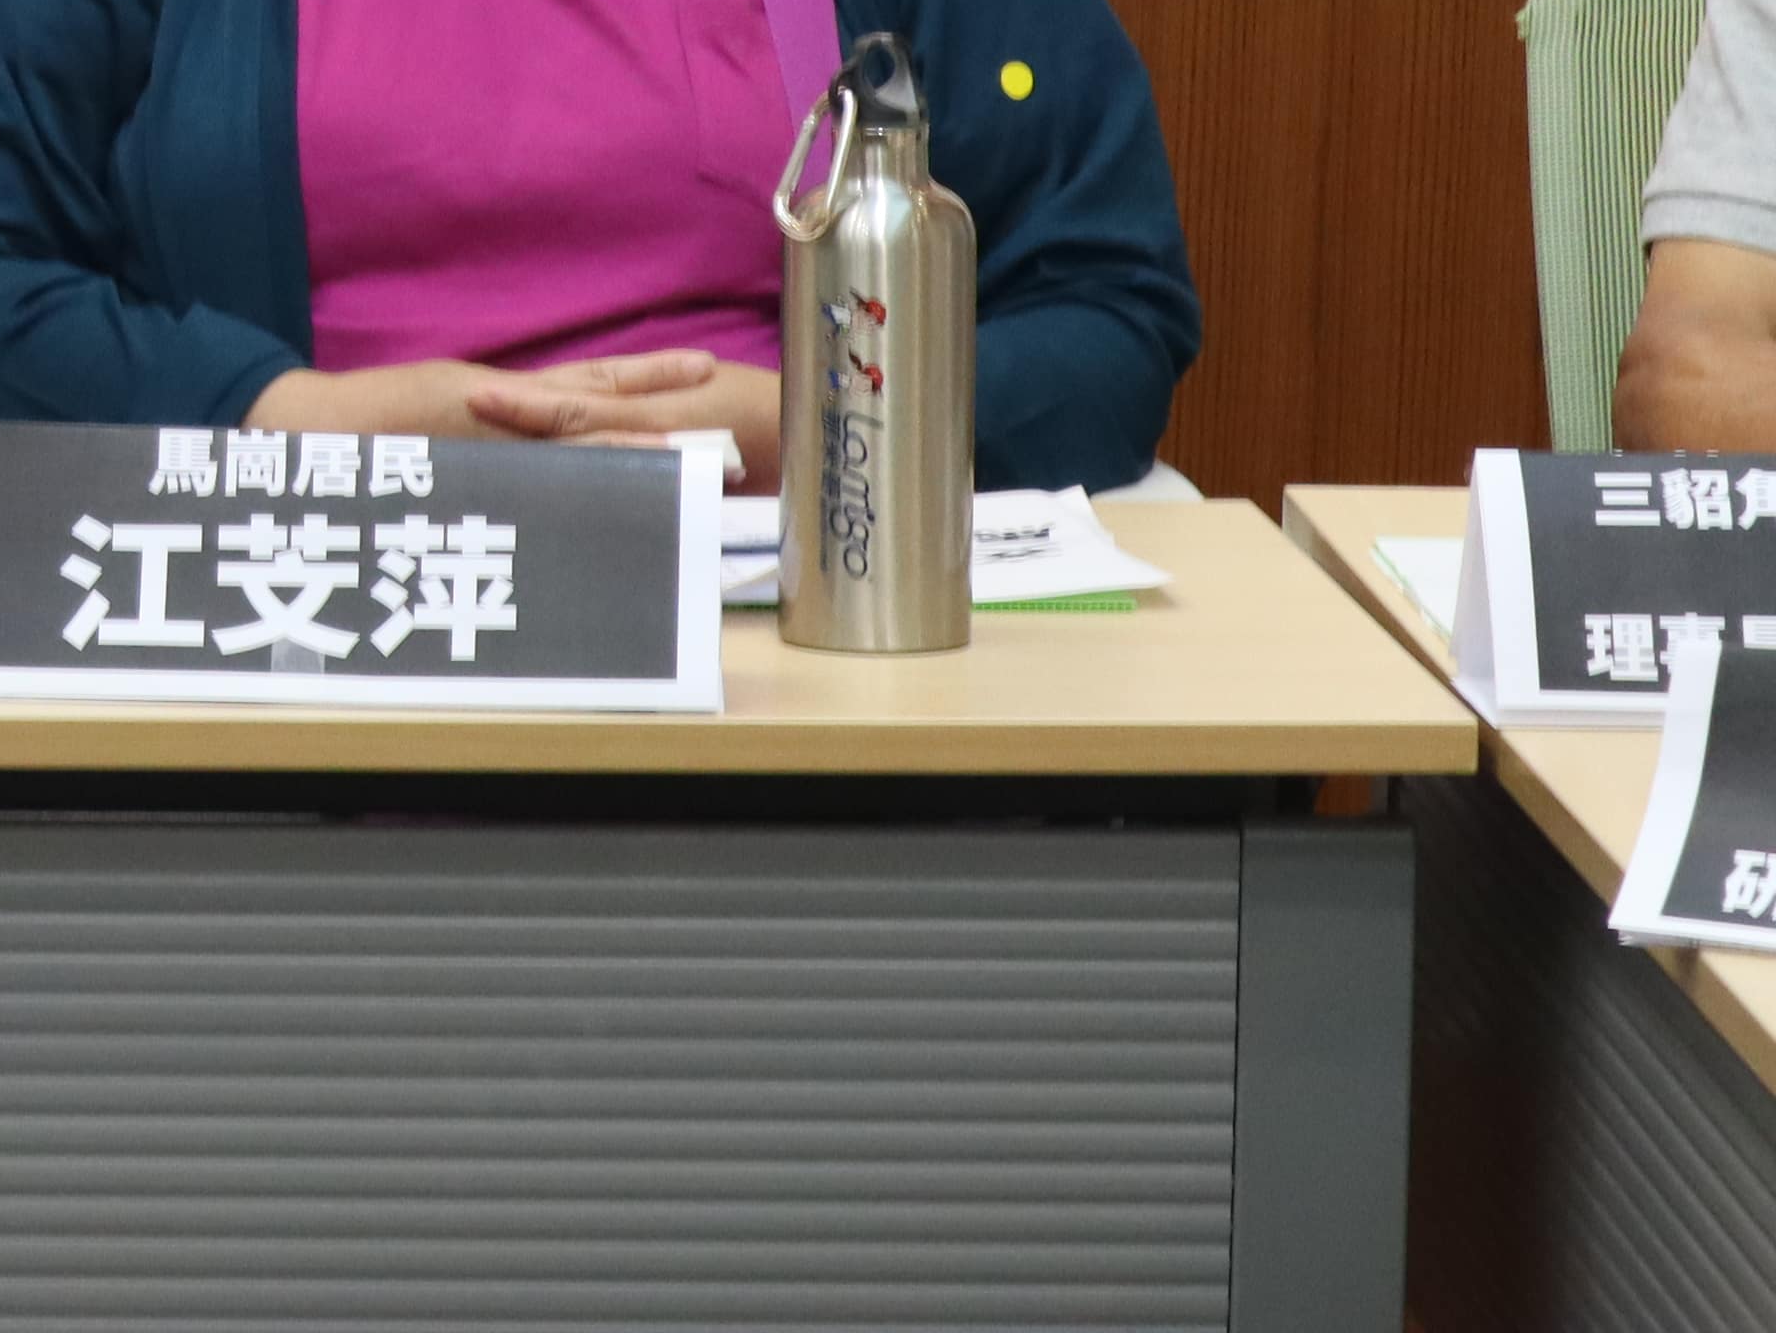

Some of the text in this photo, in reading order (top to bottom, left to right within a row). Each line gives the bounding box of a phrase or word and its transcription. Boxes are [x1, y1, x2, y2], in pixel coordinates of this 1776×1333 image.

[148, 428, 434, 498] 馬崗居民
[59, 513, 518, 662] 江芠萍
